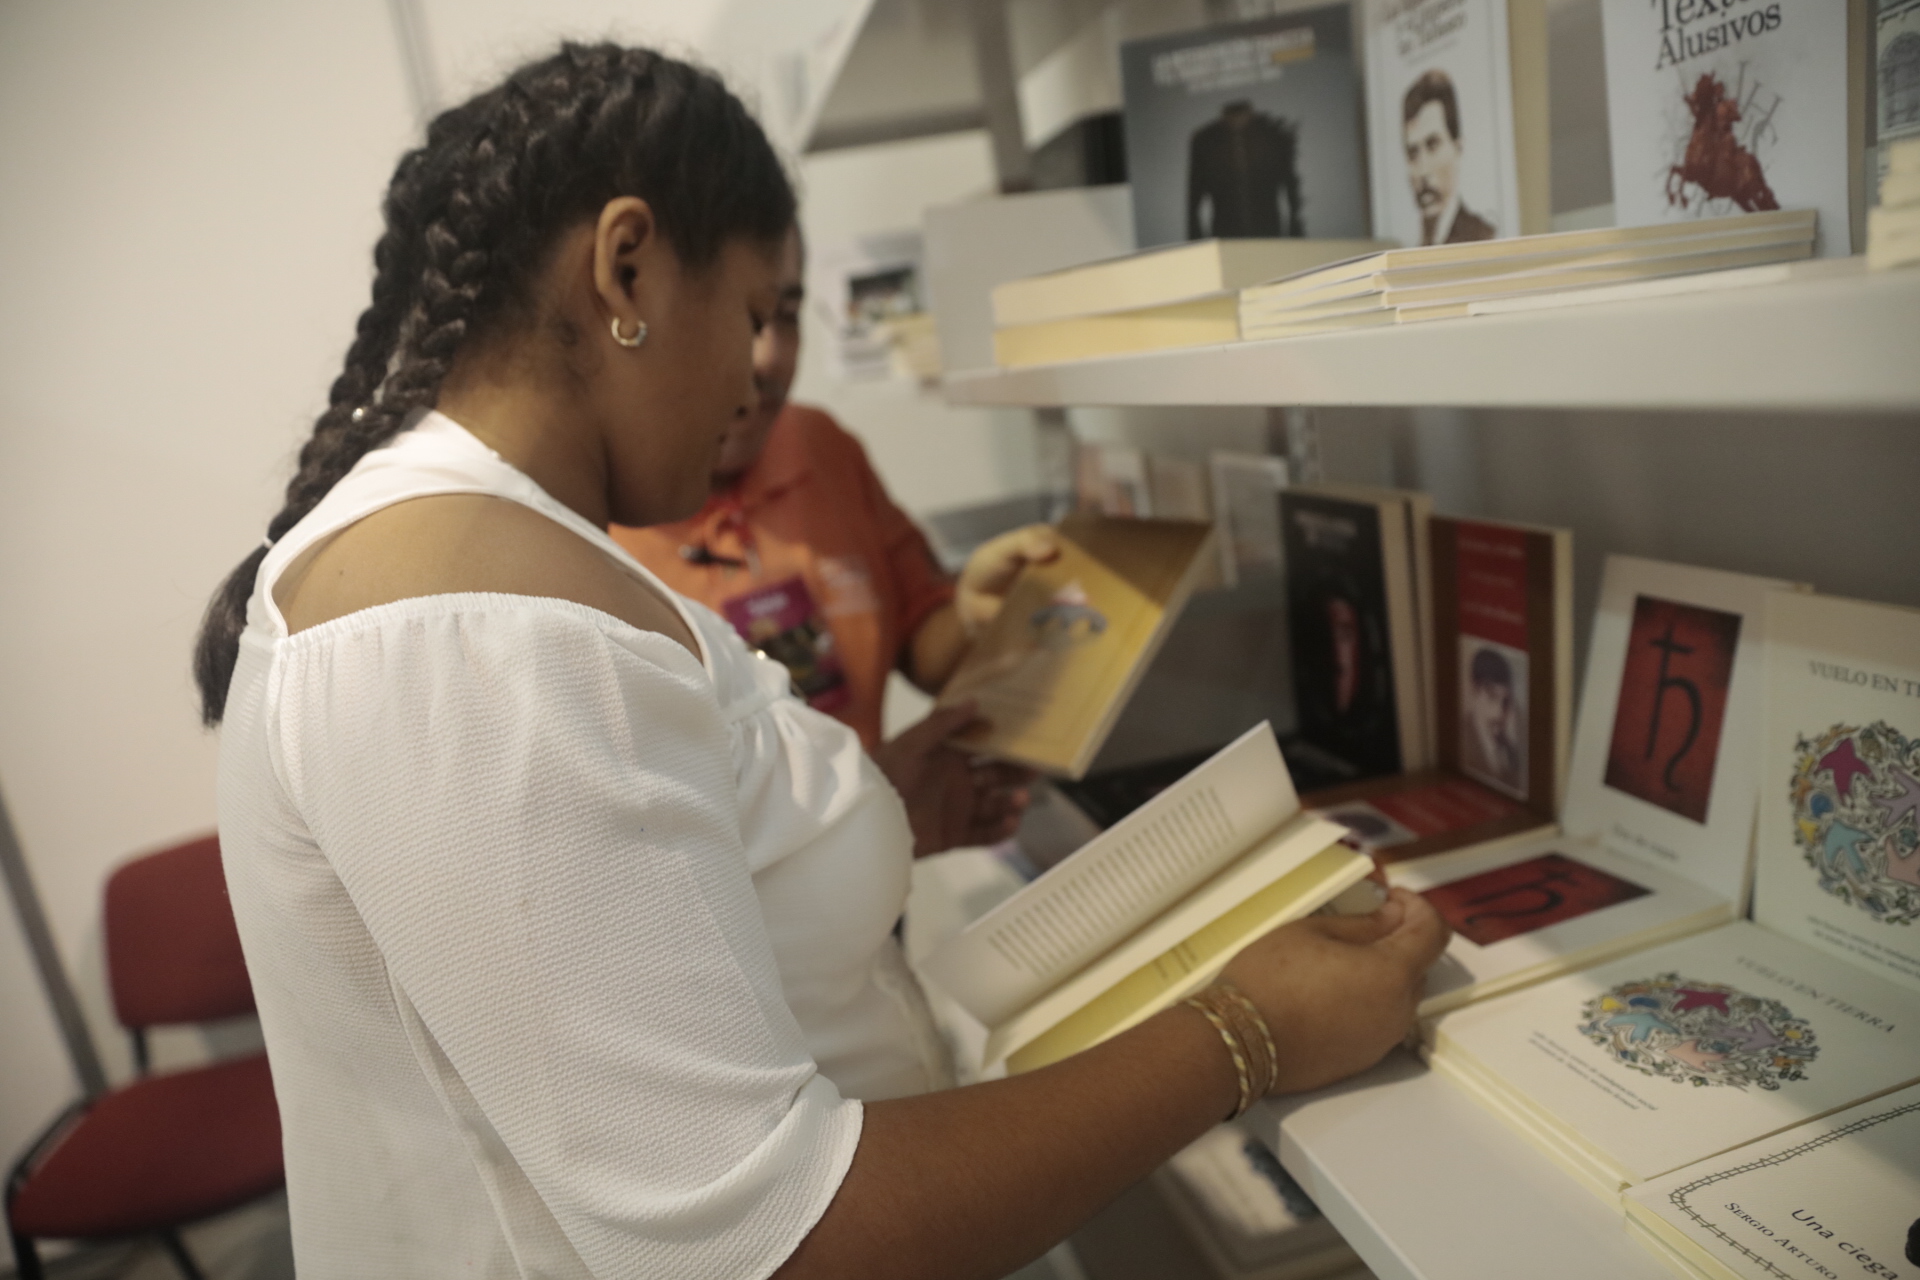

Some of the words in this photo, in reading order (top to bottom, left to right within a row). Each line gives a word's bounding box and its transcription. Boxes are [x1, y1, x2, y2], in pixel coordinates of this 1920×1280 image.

[1656, 4, 1782, 70] Alusivos
[1808, 660, 1868, 687] VUELO
[1871, 673, 1899, 692] EN
[1724, 1202, 1775, 1237] SERGIO
[1774, 1238, 1838, 1280] ARTURO
[1791, 1209, 1835, 1239] Una
[1838, 1241, 1899, 1280] ciega
